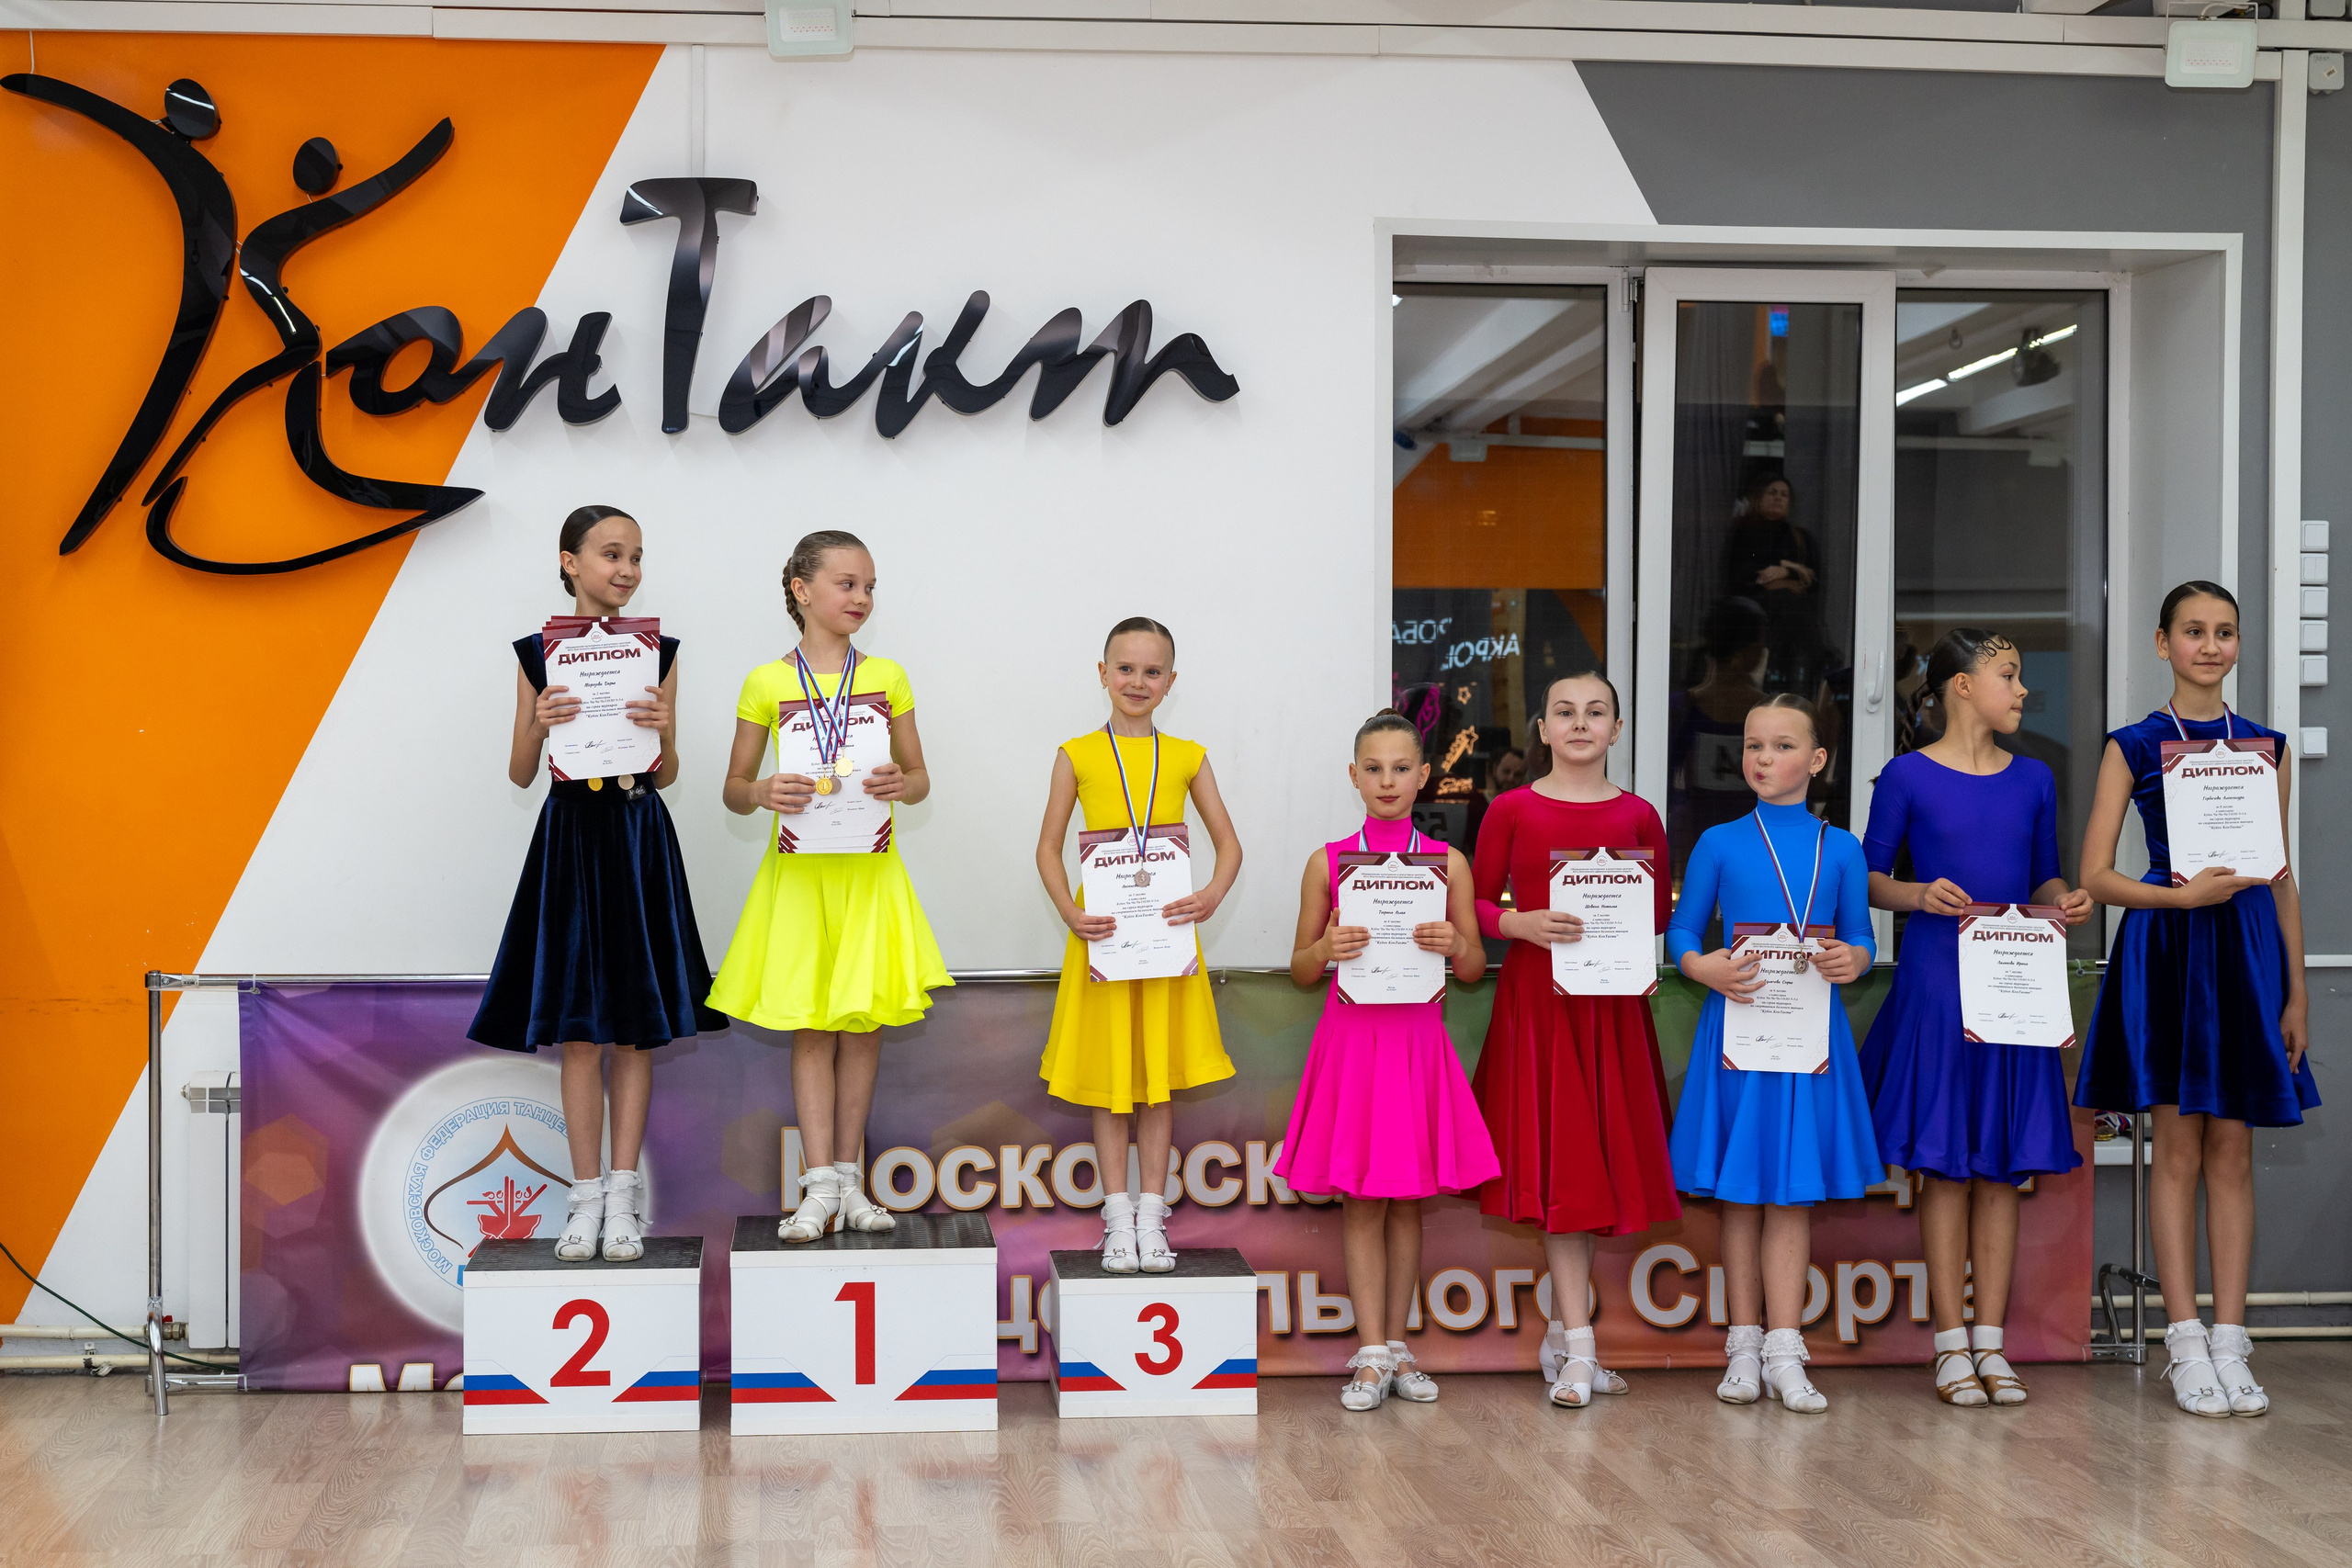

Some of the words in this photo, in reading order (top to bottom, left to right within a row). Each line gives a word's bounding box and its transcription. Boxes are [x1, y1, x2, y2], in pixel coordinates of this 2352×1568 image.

[558, 648, 641, 665] ДИПЛОМ
[580, 670, 620, 678] Награждается
[791, 716, 875, 732] ДИОМ
[2181, 766, 2264, 778] ДИПЛОМ
[1094, 851, 1176, 868] ДИПЛОМ
[1140, 874, 1146, 883] 3
[1352, 880, 1435, 891] ДИПЛОМ
[1562, 874, 1642, 886] ДИПЛОМ
[1973, 931, 2054, 943] ДИПЛОМ
[1994, 949, 2033, 957] Награждается
[419, 1100, 511, 1161] ФЕДЕРАЦИЯ
[407, 1161, 454, 1275] МОСКОВСКАЯ
[834, 1281, 876, 1385] 1
[1134, 1303, 1184, 1376] 3
[550, 1299, 611, 1388] 2
